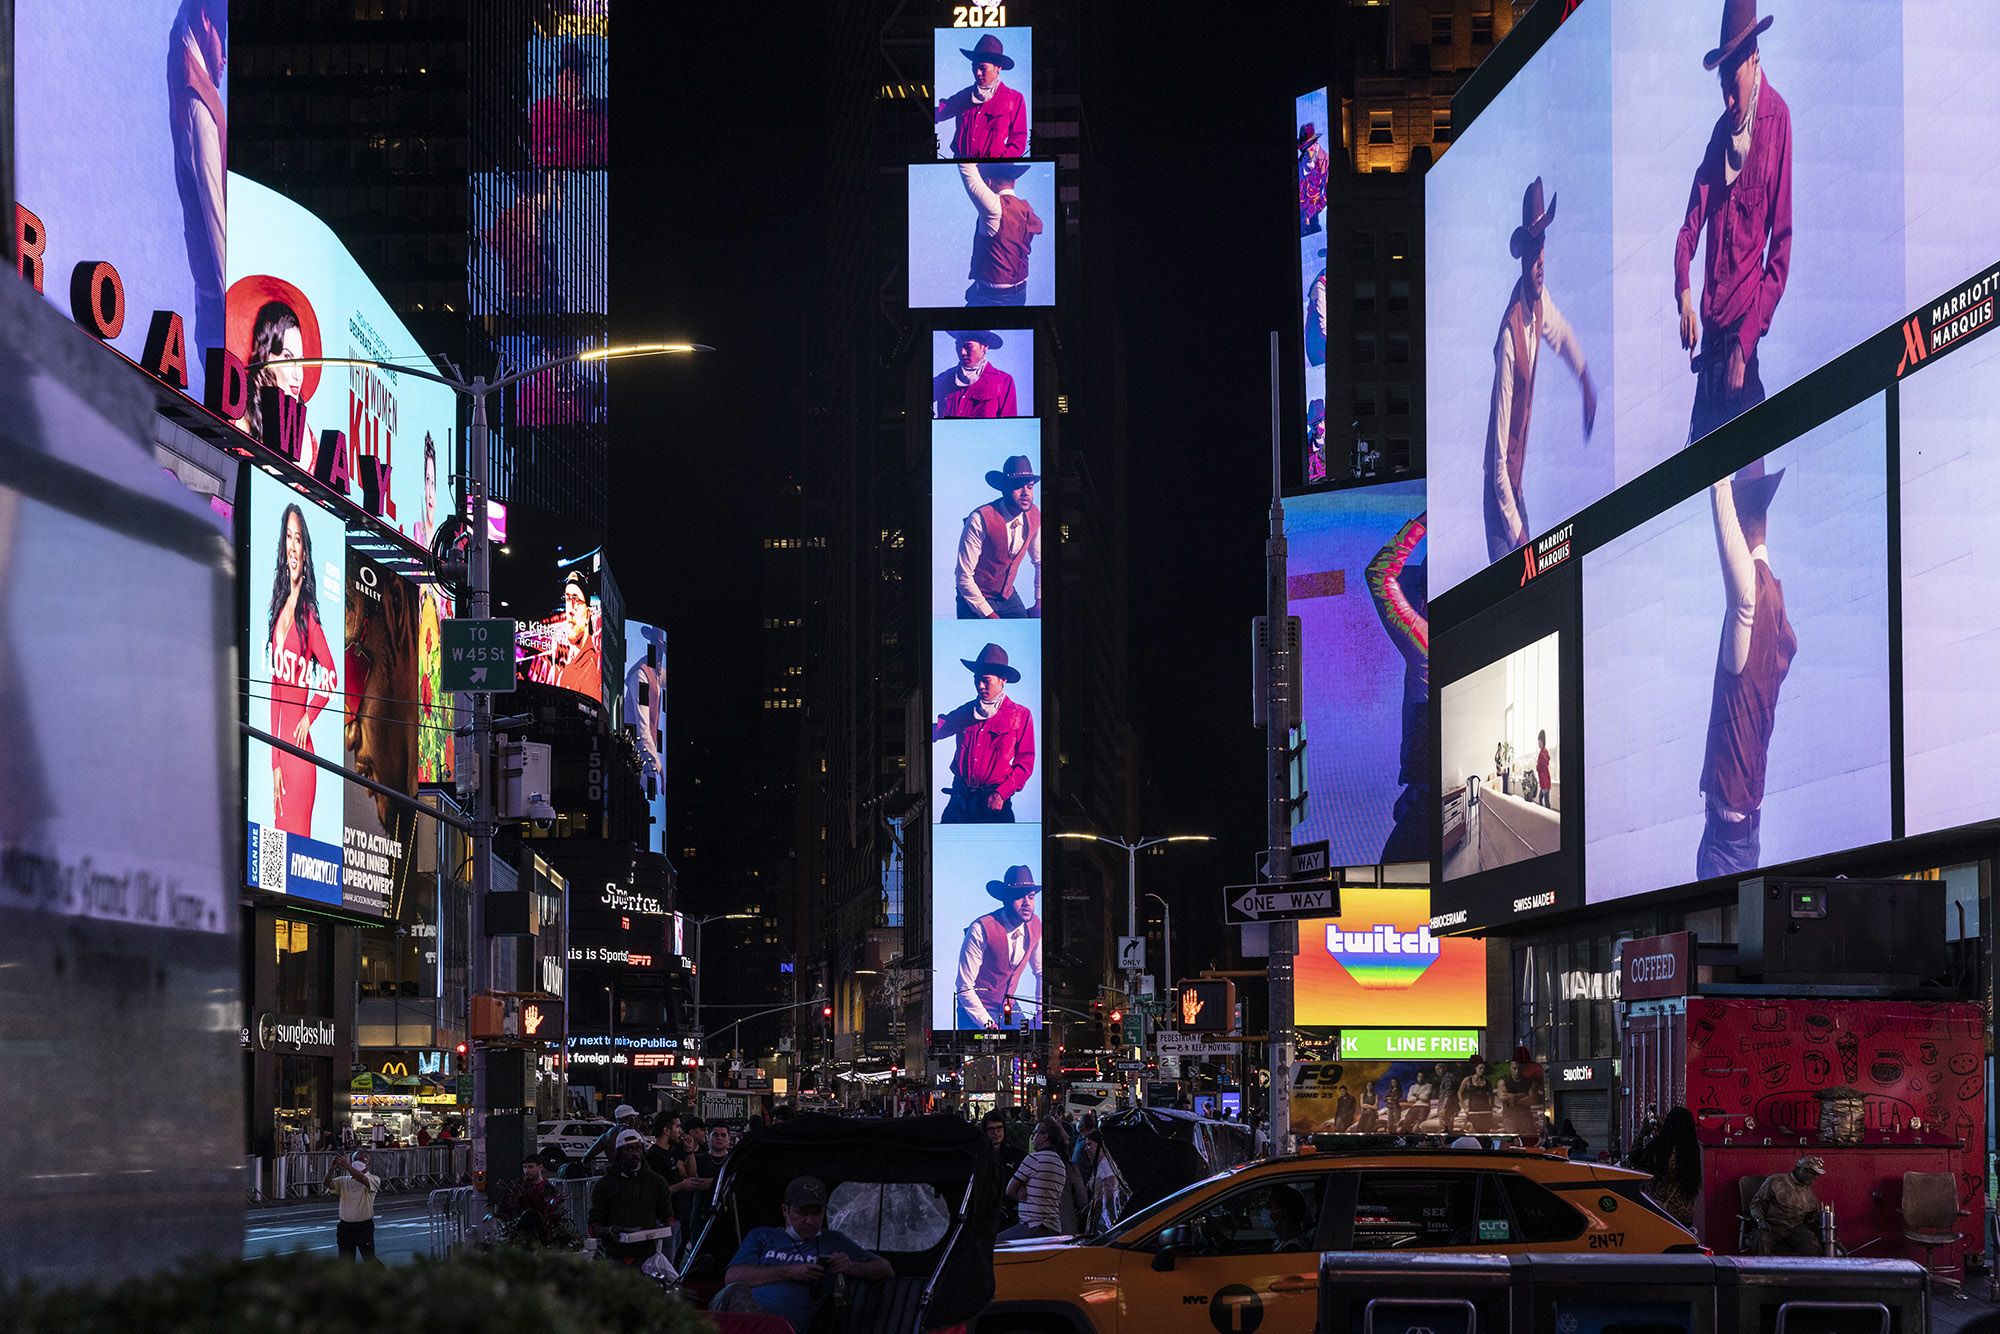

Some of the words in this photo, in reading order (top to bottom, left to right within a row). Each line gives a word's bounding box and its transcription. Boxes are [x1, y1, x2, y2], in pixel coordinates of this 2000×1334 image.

[953, 6, 1006, 28] 2021
[1932, 272, 2000, 326] MARRIOTT
[1933, 302, 1991, 350] MARQUIS
[371, 370, 397, 436] WOMEN
[1539, 523, 1573, 554] MARRIOTT
[1539, 544, 1569, 571] MARQUIS
[355, 581, 382, 602] OAKLEY
[469, 627, 488, 641] TO
[452, 648, 463, 662] W
[466, 648, 487, 662] 45
[491, 648, 505, 661] St
[268, 642, 298, 684] LOST
[298, 655, 314, 690] 24
[252, 828, 259, 847] ME
[355, 830, 367, 848] TO
[367, 834, 402, 860] ACTIVATE
[291, 852, 339, 887] HYDROXYCUT
[343, 847, 366, 868] YOUR
[366, 853, 389, 876] INNER
[1297, 853, 1320, 870] WAY
[343, 867, 394, 896] UPERPOWER?
[1243, 896, 1275, 911] ONE
[1290, 892, 1324, 908] WAY
[1513, 896, 1532, 912] SWISS
[1532, 891, 1550, 908] MADE
[1326, 924, 1440, 954] twitch
[1631, 953, 1675, 983] COFFEED
[277, 1019, 318, 1050] sunglass
[320, 1020, 335, 1046] hut
[580, 1036, 602, 1046] next
[1387, 1036, 1427, 1052] LINE
[1740, 1036, 1792, 1053] Espresso
[1208, 1043, 1231, 1051] MOVING
[573, 1053, 610, 1065] foreign
[634, 1054, 675, 1066] ESPN
[1161, 1057, 1178, 1067] 25
[1294, 1064, 1343, 1085] F9
[1563, 1065, 1588, 1081] swatch
[1770, 1100, 1820, 1128] COFFE
[1865, 1101, 1901, 1129] TEA
[1479, 1220, 1509, 1231] curb
[1588, 1233, 1625, 1249] 2N97
[1183, 1295, 1208, 1305] NYC
[1222, 1294, 1251, 1332] T
